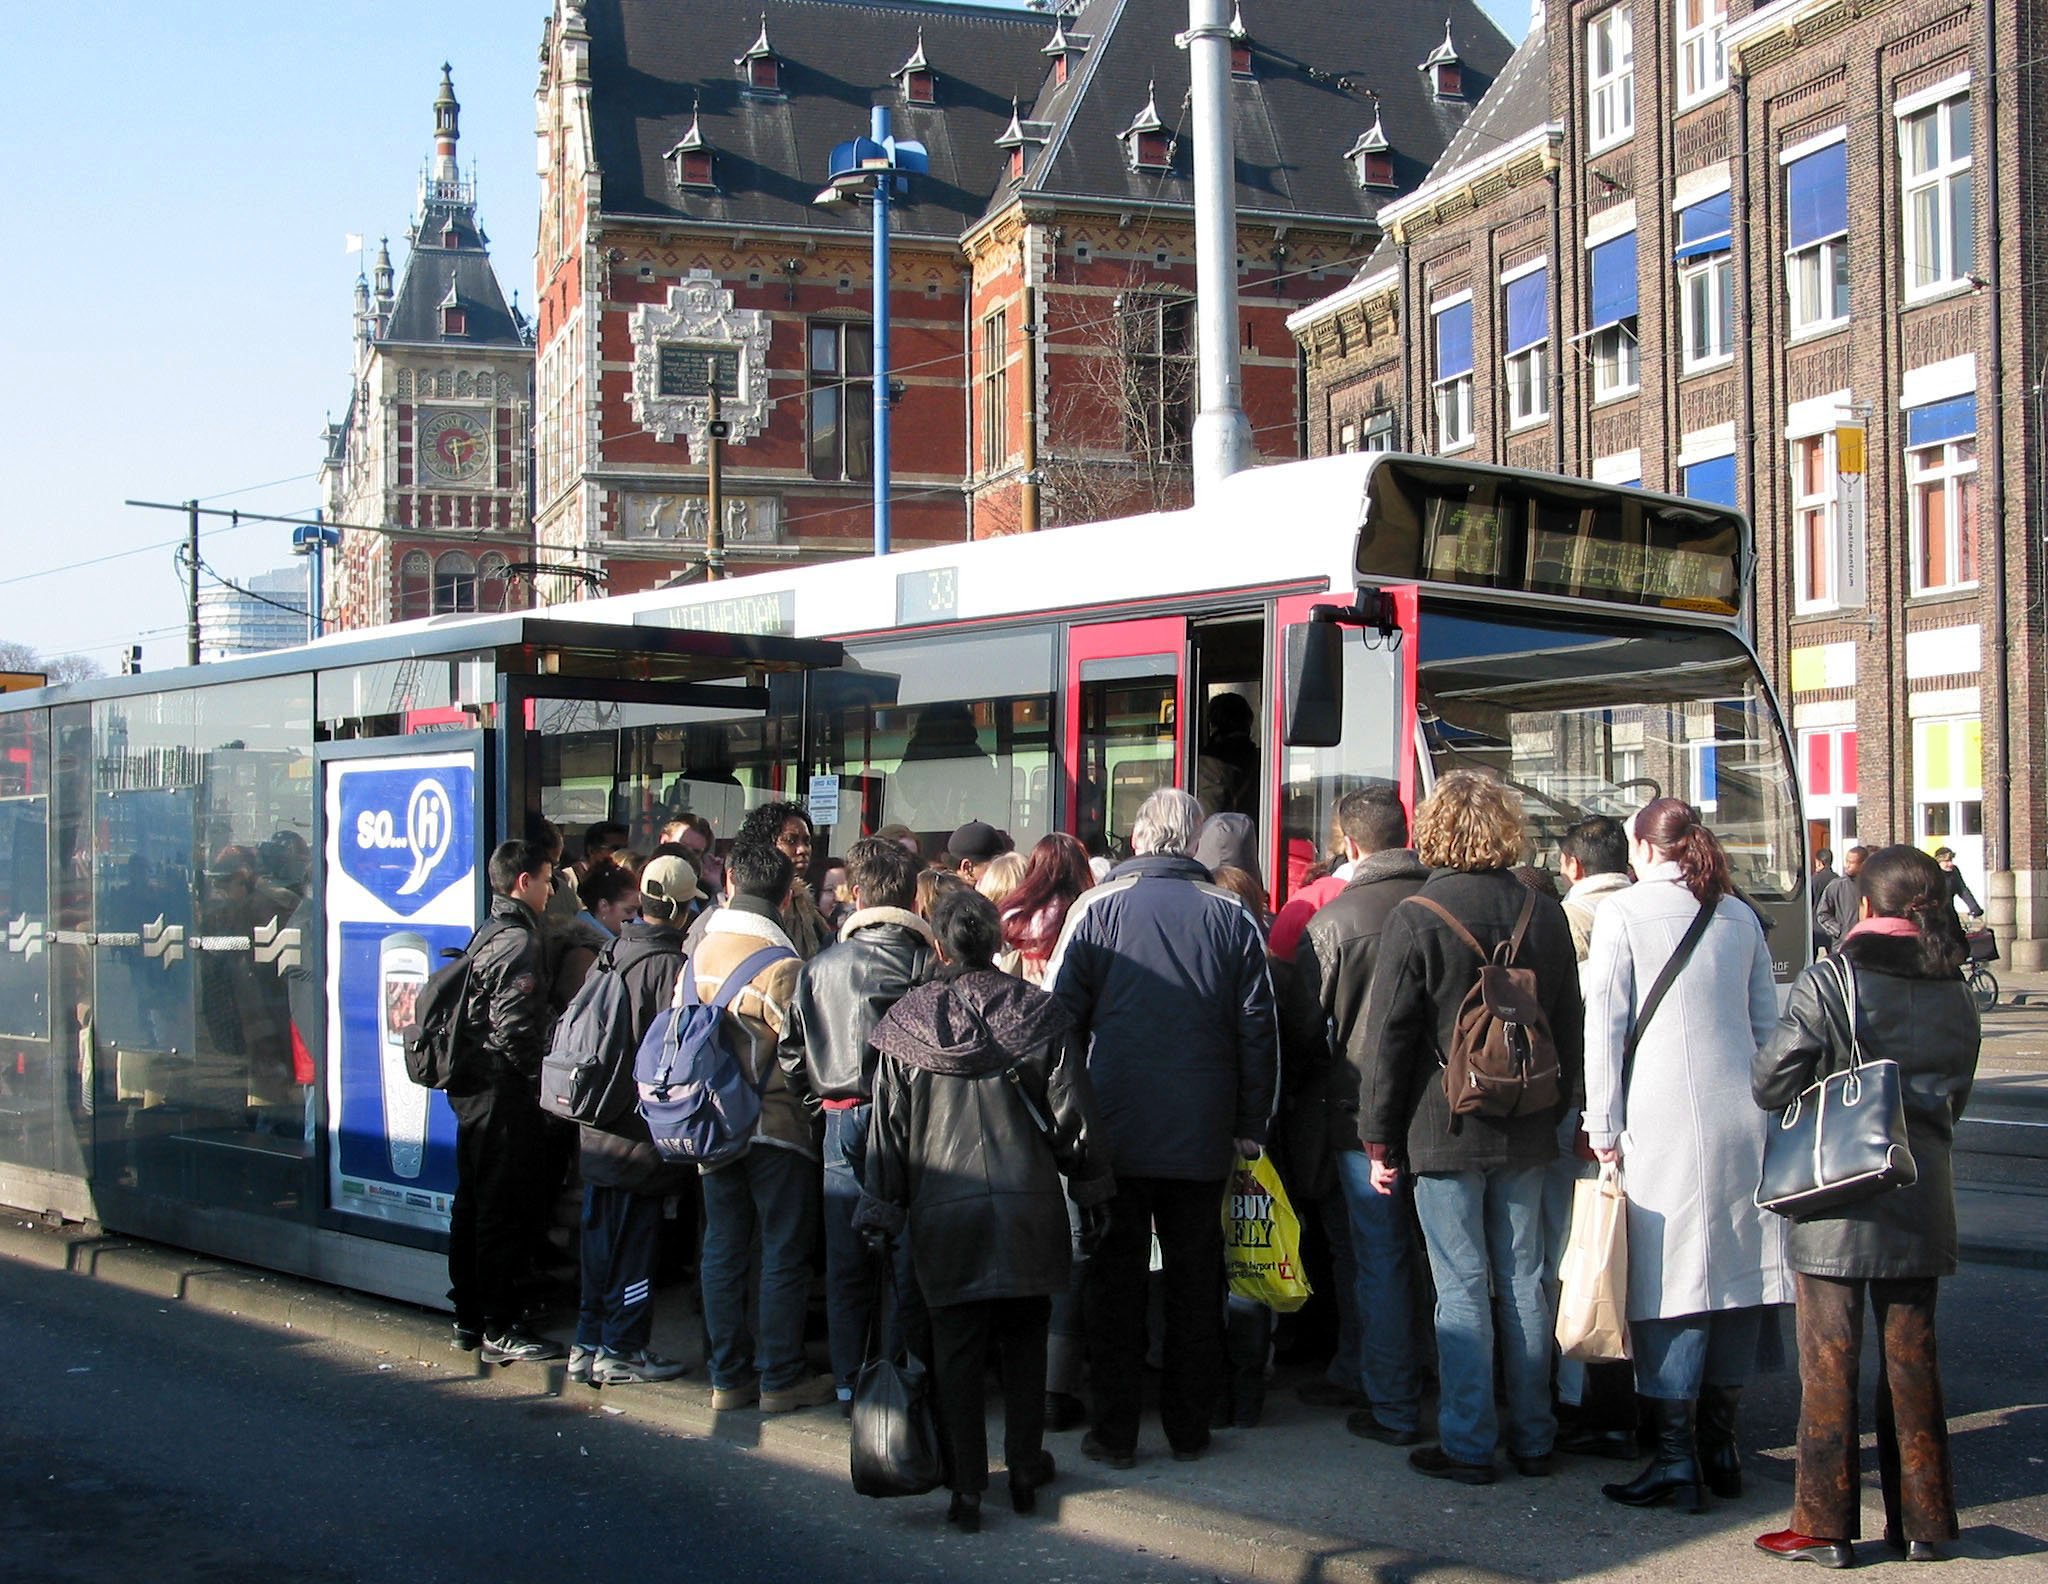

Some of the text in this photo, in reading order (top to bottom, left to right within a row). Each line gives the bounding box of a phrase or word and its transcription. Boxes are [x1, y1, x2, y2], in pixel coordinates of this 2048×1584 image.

[928, 569, 954, 610] 33
[1230, 1194, 1276, 1219] BUY
[1231, 1219, 1275, 1248] FLY
